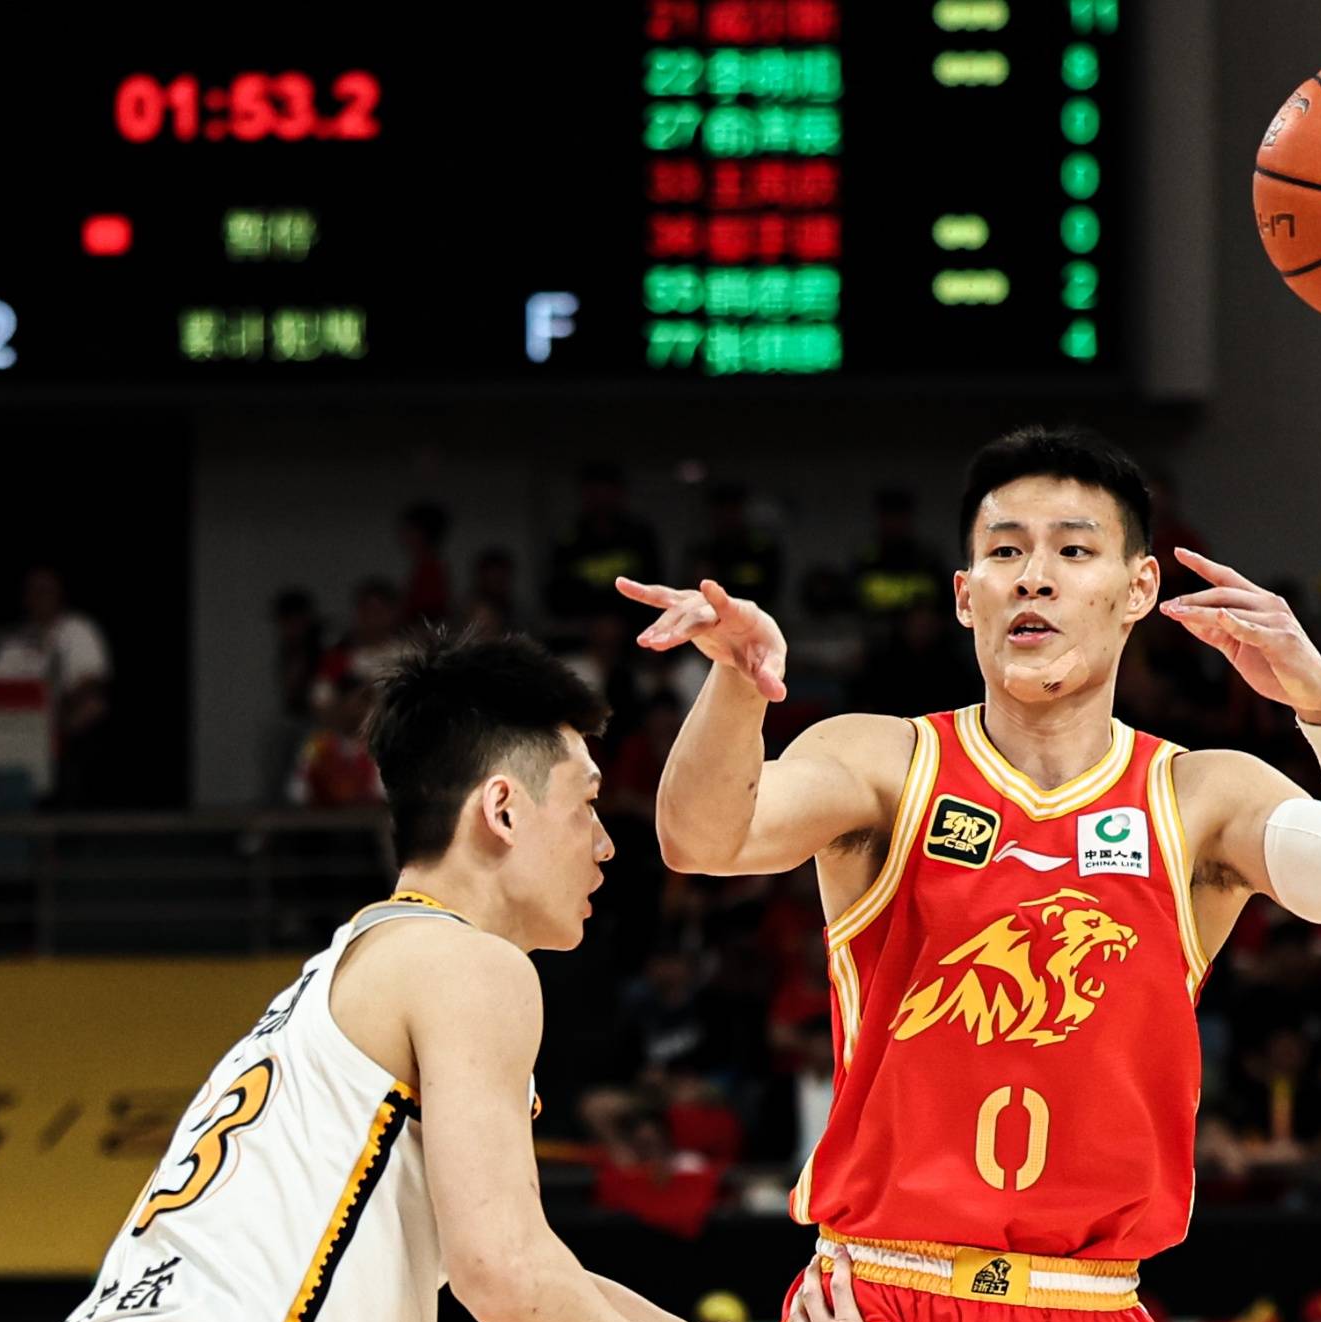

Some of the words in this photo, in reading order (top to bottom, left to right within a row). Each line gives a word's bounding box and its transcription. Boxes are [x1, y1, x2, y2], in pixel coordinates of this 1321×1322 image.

[115, 71, 379, 142] 01:53.2
[525, 292, 578, 362] F
[944, 838, 978, 855] CBA
[1084, 849, 1143, 861] 中国人寿
[1085, 860, 1118, 868] CHINA
[1121, 861, 1142, 869] LIFE
[126, 1056, 281, 1238] 3
[973, 1085, 1050, 1191] 0
[973, 1281, 1007, 1295] 浙江
